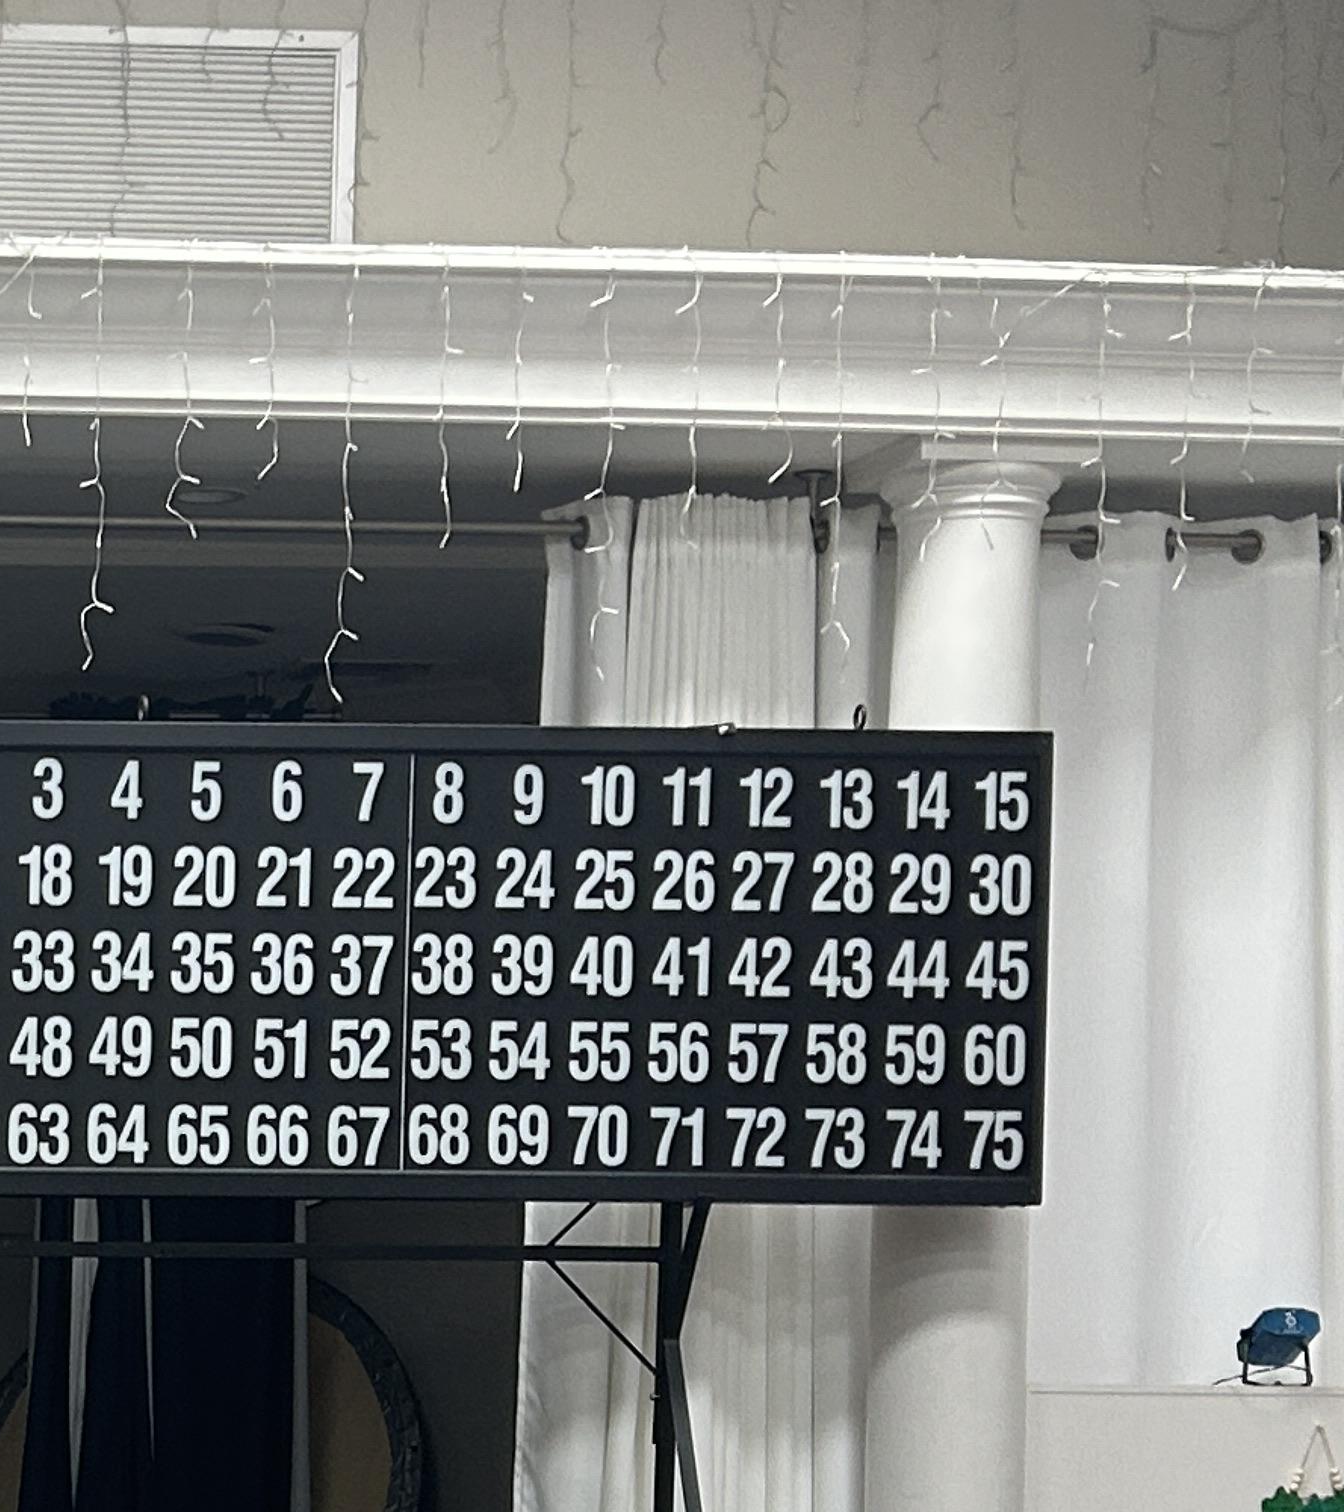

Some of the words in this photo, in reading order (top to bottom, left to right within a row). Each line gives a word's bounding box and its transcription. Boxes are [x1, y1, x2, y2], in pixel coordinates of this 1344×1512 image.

[32, 757, 64, 819] 3
[110, 759, 143, 820] 4
[190, 760, 222, 821] 5
[272, 760, 303, 822] 6
[352, 761, 384, 822] 7
[432, 761, 464, 824] 8
[513, 764, 544, 825] 9
[580, 764, 635, 827] 10
[662, 766, 712, 827] 11
[739, 767, 793, 828] 12
[819, 768, 873, 830] 13
[897, 770, 950, 830] 14
[974, 771, 1029, 831] 15
[18, 843, 73, 907] 18
[98, 844, 153, 907] 19
[172, 845, 236, 908] 20
[255, 845, 312, 908] 21
[331, 847, 395, 909] 22
[413, 846, 477, 909] 23
[494, 847, 555, 909] 24
[573, 848, 635, 911] 25
[651, 849, 715, 912] 26
[730, 850, 795, 912] 27
[811, 850, 874, 913] 28
[888, 852, 951, 915] 29
[969, 853, 1032, 916] 30
[11, 929, 75, 993] 33
[91, 930, 154, 993] 34
[170, 931, 235, 994] 35
[250, 932, 314, 996] 36
[330, 933, 394, 996] 37
[411, 932, 474, 996] 38
[491, 933, 554, 996] 39
[569, 935, 634, 997] 40
[652, 936, 710, 997] 41
[728, 936, 792, 998] 42
[809, 937, 873, 999] 43
[886, 939, 950, 999] 44
[965, 940, 1030, 1000] 45
[9, 1015, 73, 1078] 48
[88, 1015, 152, 1077] 49
[170, 1016, 232, 1079] 50
[253, 1018, 307, 1079] 51
[329, 1018, 391, 1080] 52
[410, 1018, 472, 1080] 53
[488, 1020, 551, 1081] 54
[568, 1020, 631, 1082] 55
[647, 1021, 709, 1083] 56
[727, 1023, 789, 1083] 57
[805, 1023, 867, 1085] 58
[885, 1023, 946, 1085] 59
[964, 1024, 1026, 1086] 60
[7, 1102, 70, 1165] 63
[87, 1102, 150, 1165] 64
[167, 1103, 230, 1165] 65
[246, 1104, 309, 1166] 66
[327, 1104, 391, 1167] 67
[408, 1103, 470, 1165] 68
[487, 1103, 549, 1166] 69
[567, 1104, 628, 1167] 70
[650, 1106, 705, 1167] 71
[725, 1106, 786, 1167] 72
[804, 1107, 865, 1169] 73
[886, 1109, 942, 1169] 74
[963, 1110, 1024, 1170] 75
